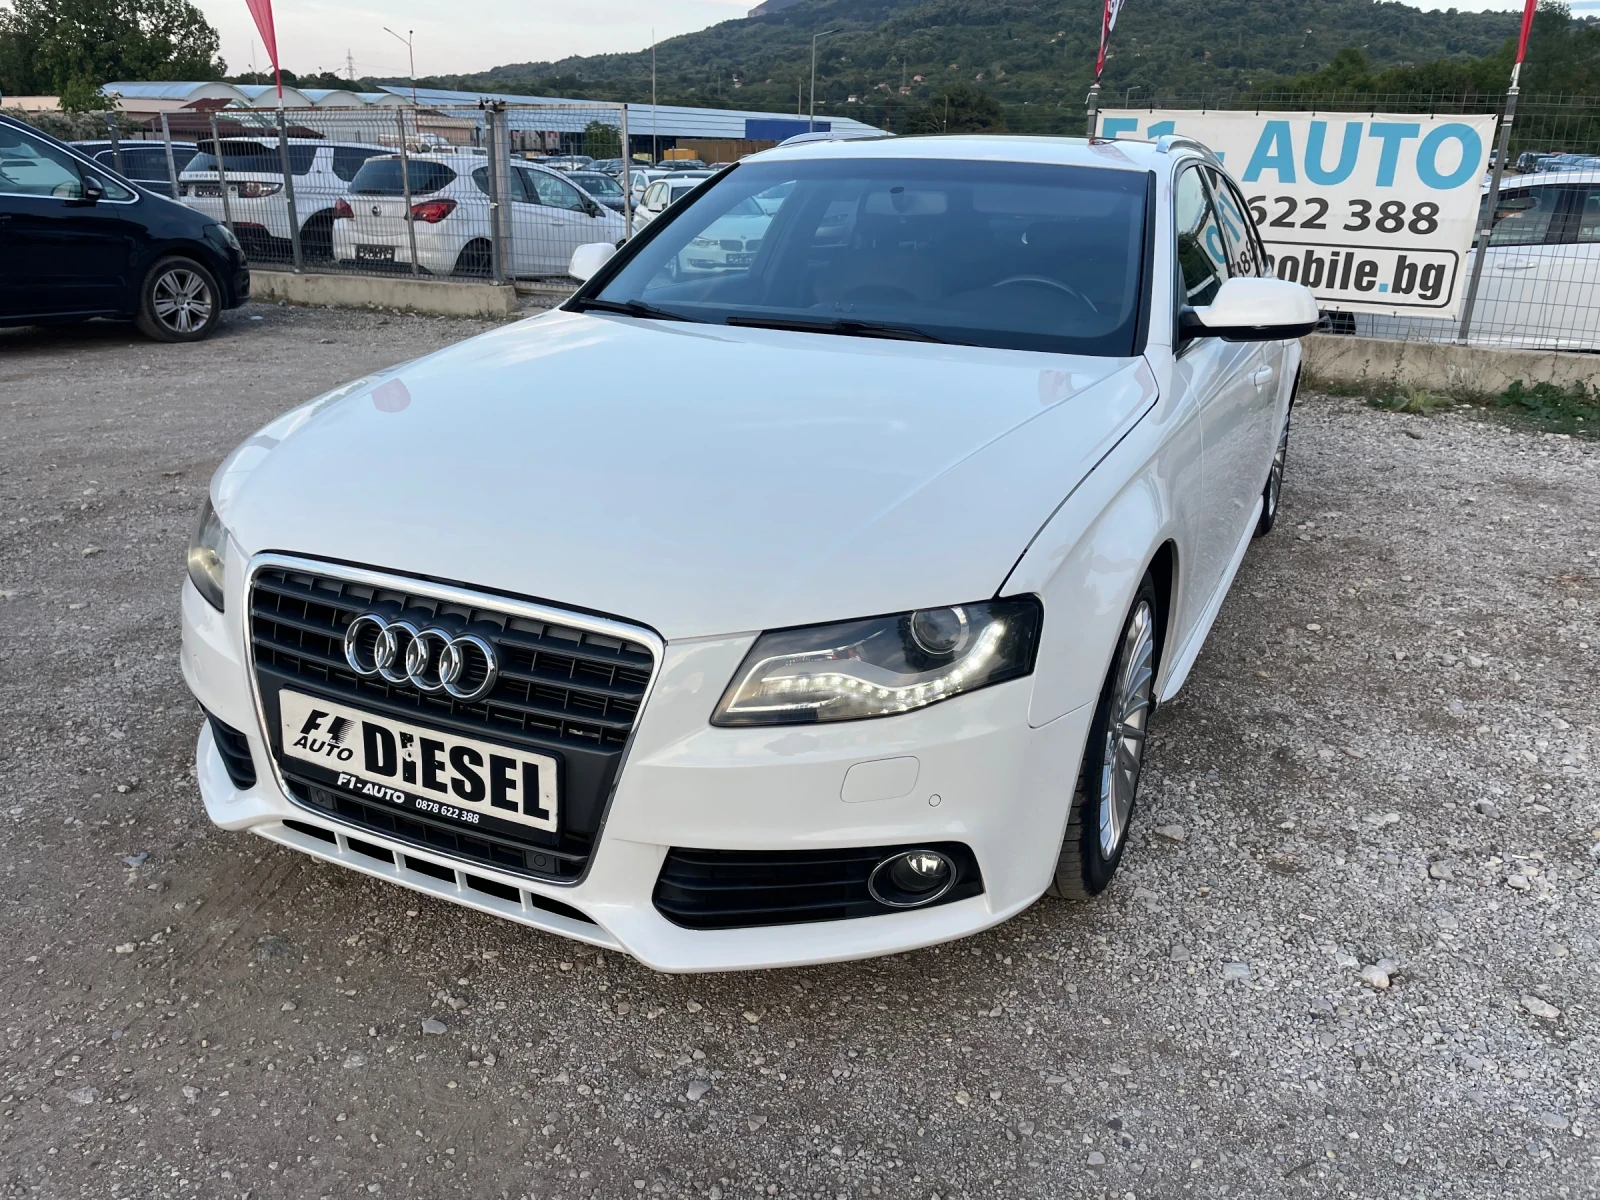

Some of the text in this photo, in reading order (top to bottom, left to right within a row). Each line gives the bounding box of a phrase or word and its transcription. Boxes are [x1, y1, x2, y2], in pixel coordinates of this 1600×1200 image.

[1242, 120, 1482, 190] AUTO
[1343, 199, 1440, 235] 388
[293, 735, 354, 761] AUTO
[415, 798, 440, 813] 0878
[440, 805, 459, 818] 622
[460, 810, 480, 824] 388
